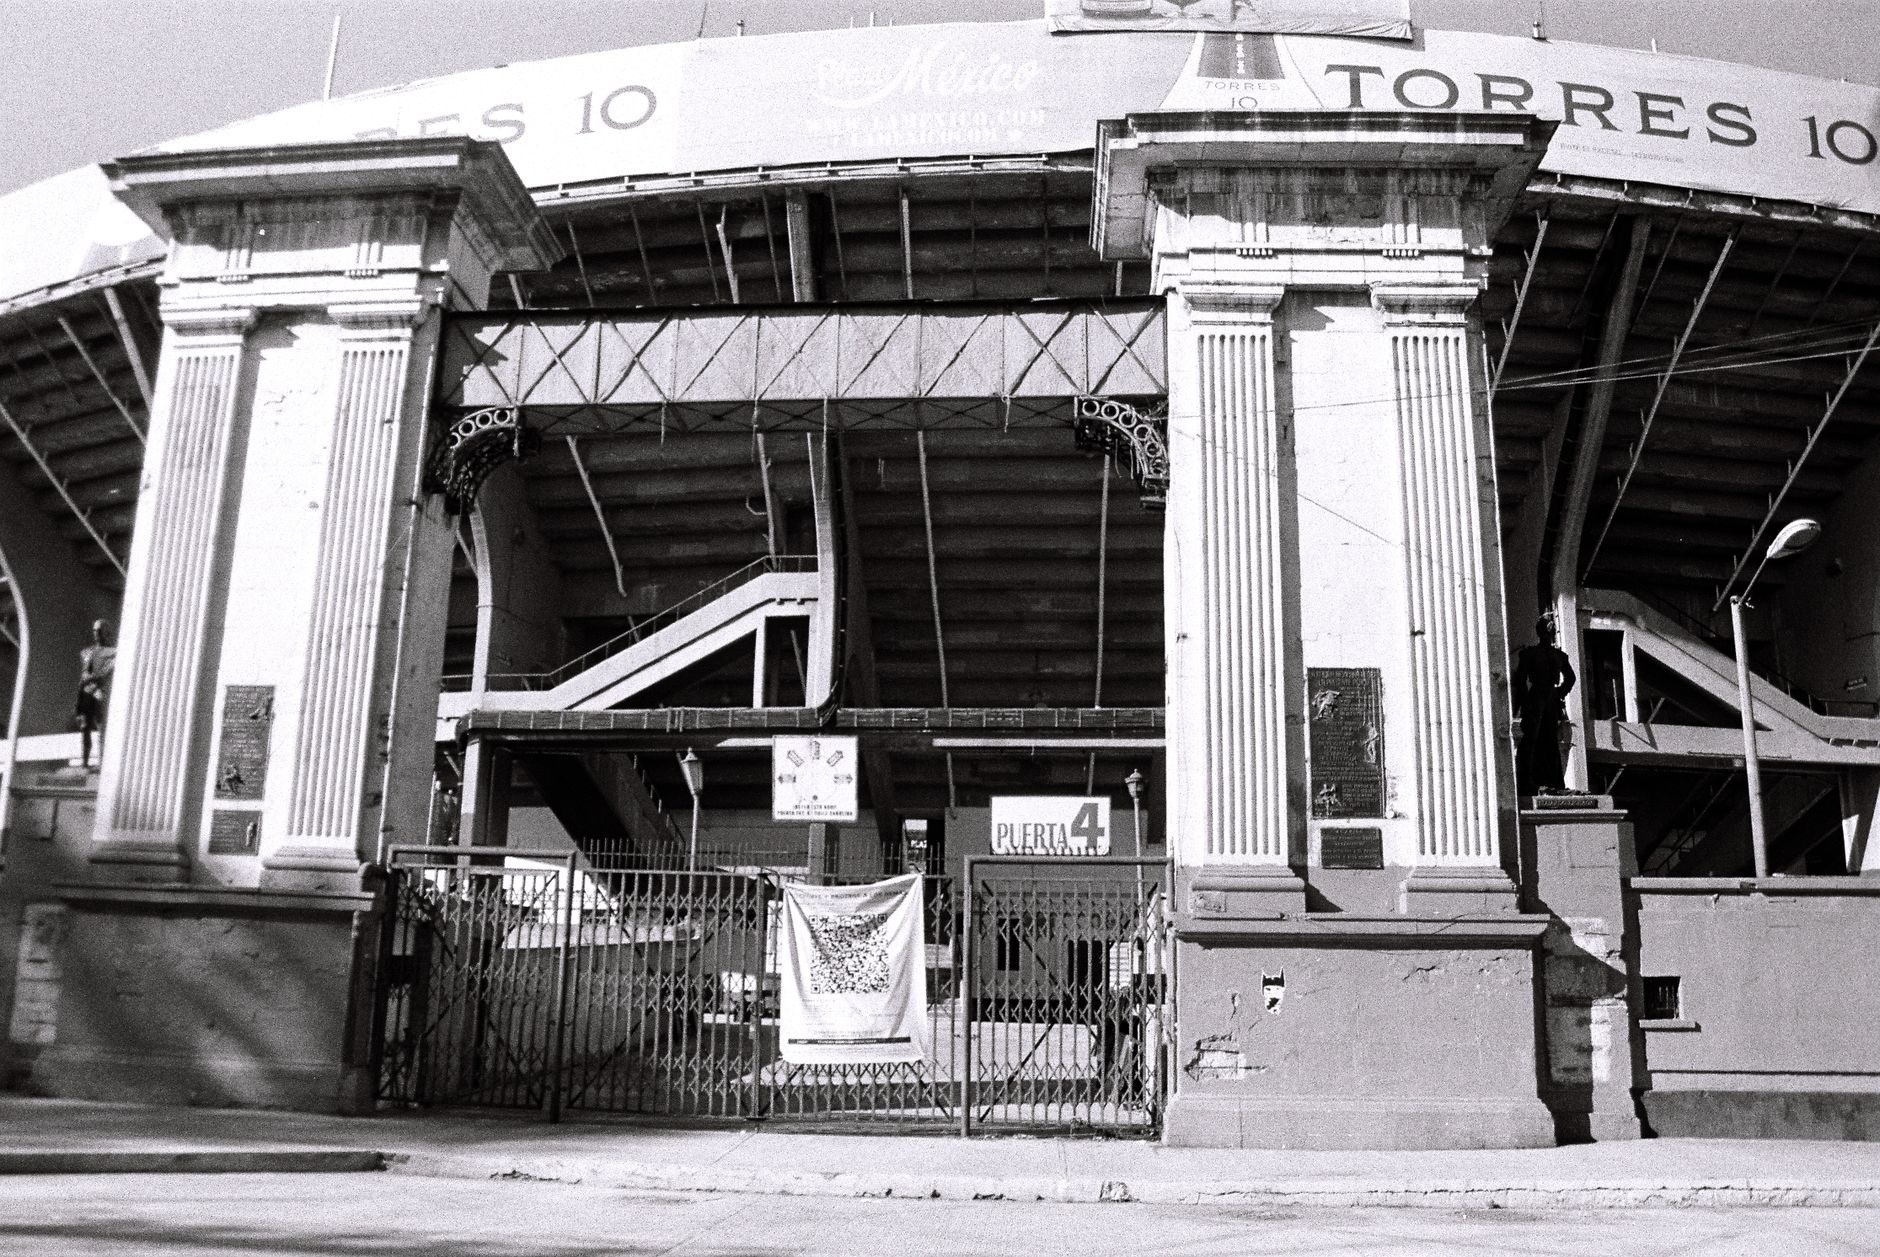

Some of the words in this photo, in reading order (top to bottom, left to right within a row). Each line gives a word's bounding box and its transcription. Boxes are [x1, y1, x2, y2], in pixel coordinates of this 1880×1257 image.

[575, 84, 657, 135] 10
[1204, 80, 1281, 92] TORRES
[1231, 96, 1259, 110] 10
[1324, 62, 1759, 148] TORRES
[1800, 115, 1878, 166] 10
[997, 822, 1069, 850] PUERTA
[1070, 802, 1106, 850] 4
